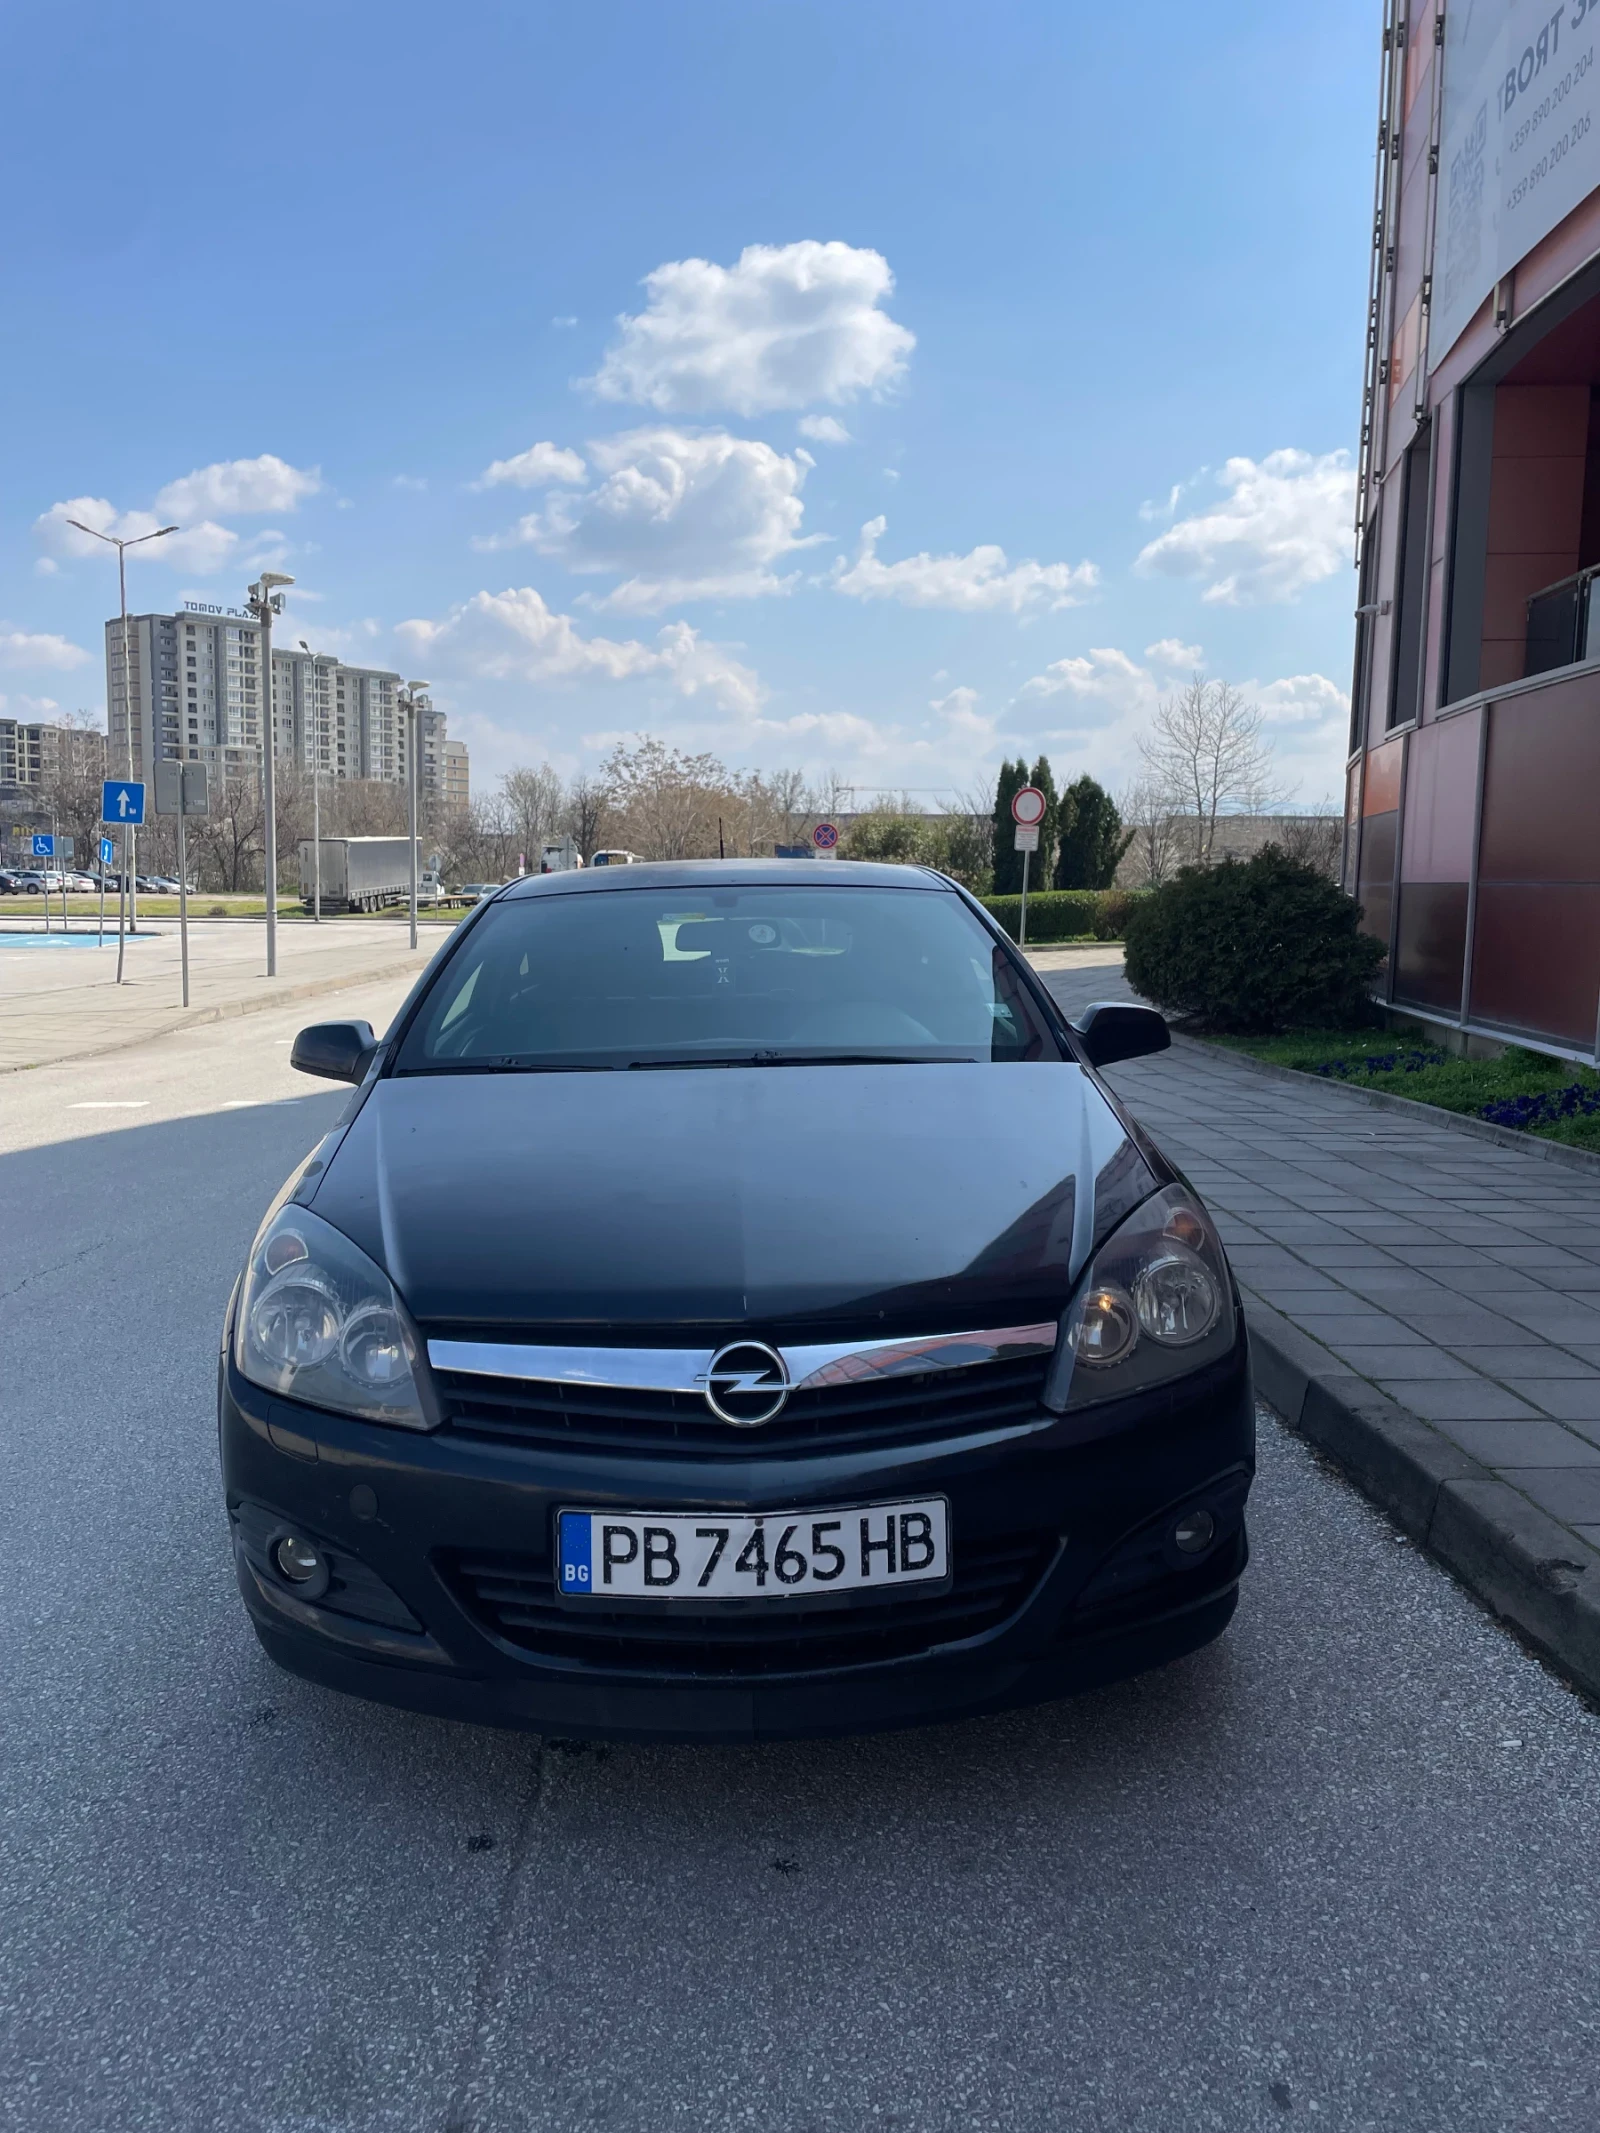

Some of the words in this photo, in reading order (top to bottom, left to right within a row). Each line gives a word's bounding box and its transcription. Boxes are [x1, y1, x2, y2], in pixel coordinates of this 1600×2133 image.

[1571, 0, 1600, 30] З
[1509, 119, 1531, 153] +359
[1532, 97, 1551, 131] 890
[1552, 72, 1572, 110] 200
[1573, 45, 1593, 86] 204
[1507, 177, 1528, 210] +359
[1529, 156, 1548, 190] 890
[1549, 133, 1569, 170] 200
[1571, 110, 1591, 147] 206
[184, 600, 222, 614] TOMOV
[564, 1564, 589, 1583] BG
[602, 1525, 680, 1586] PB
[695, 1521, 846, 1587] 7465
[859, 1512, 936, 1577] HB
